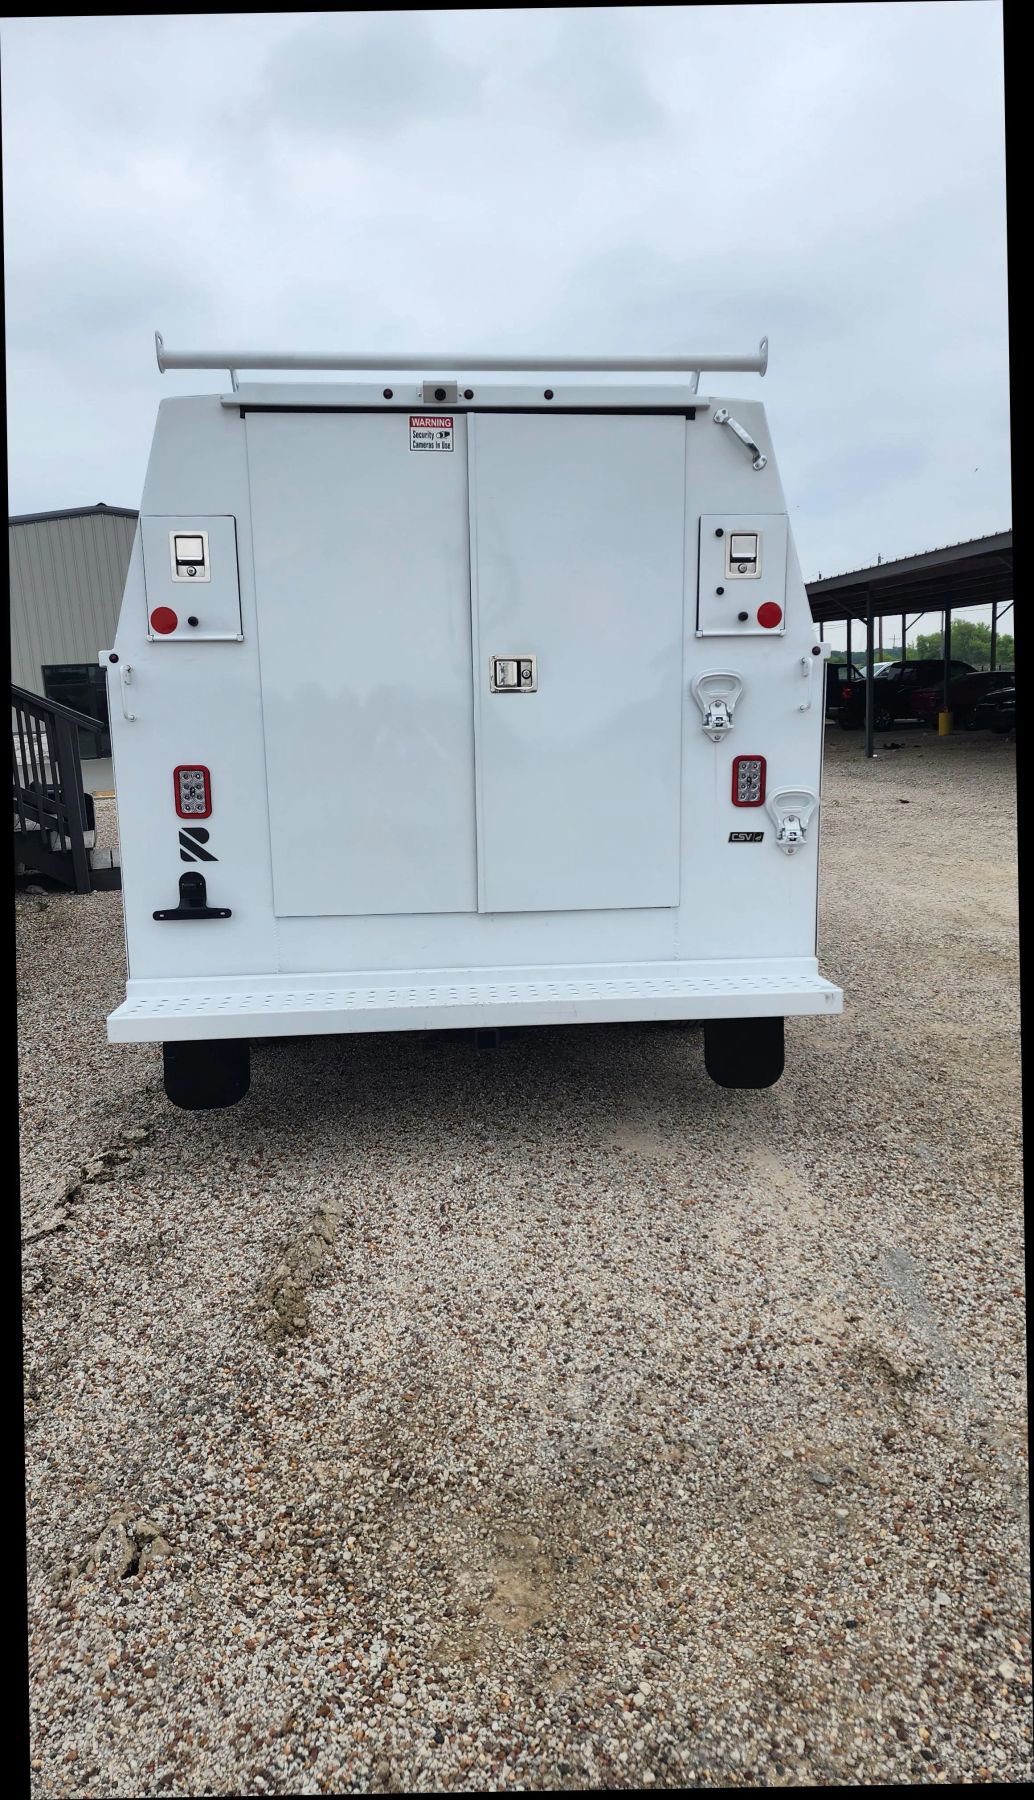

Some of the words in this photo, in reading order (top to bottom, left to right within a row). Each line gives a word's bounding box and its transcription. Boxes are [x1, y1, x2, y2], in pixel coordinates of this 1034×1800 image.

[411, 417, 452, 428] WARNING
[412, 430, 435, 441] Security
[412, 440, 434, 449] Cameras
[435, 440, 441, 449] In
[441, 440, 451, 450] Use
[731, 832, 753, 841] CSV
